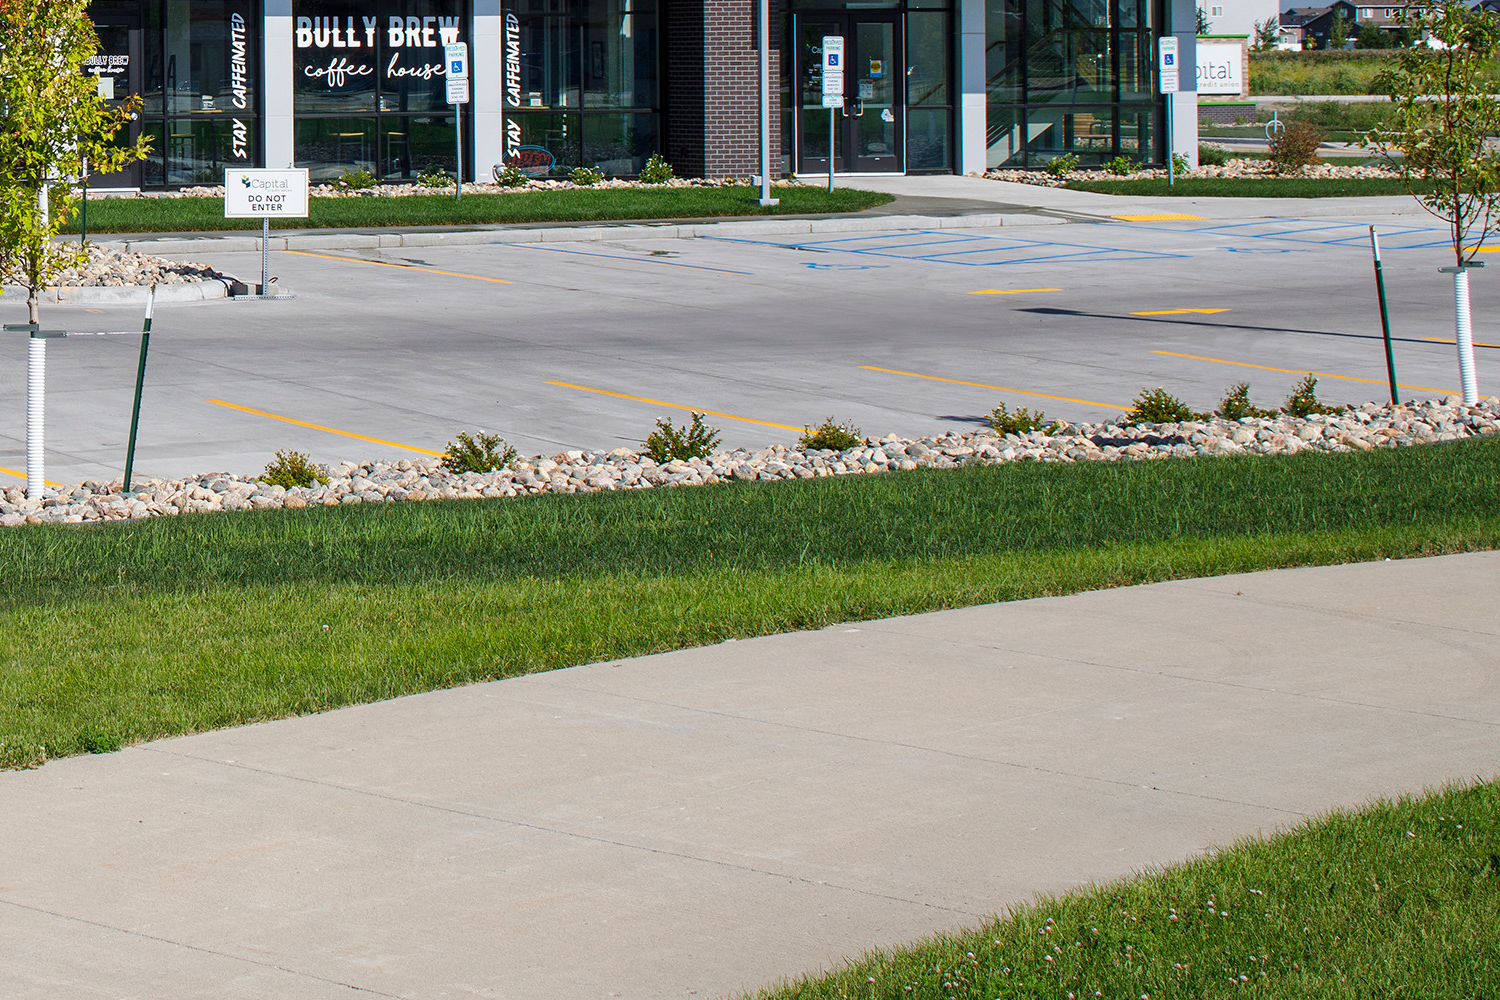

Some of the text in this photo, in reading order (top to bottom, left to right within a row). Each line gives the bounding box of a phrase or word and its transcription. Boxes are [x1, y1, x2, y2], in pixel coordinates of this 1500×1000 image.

[296, 16, 460, 48] BULLY BREW
[108, 55, 129, 65] BREW
[304, 52, 447, 87] coffee house
[231, 12, 247, 159] STAY CAFFEINATED
[506, 13, 521, 158] STAY CAFFEINATED
[251, 179, 289, 190] Capital
